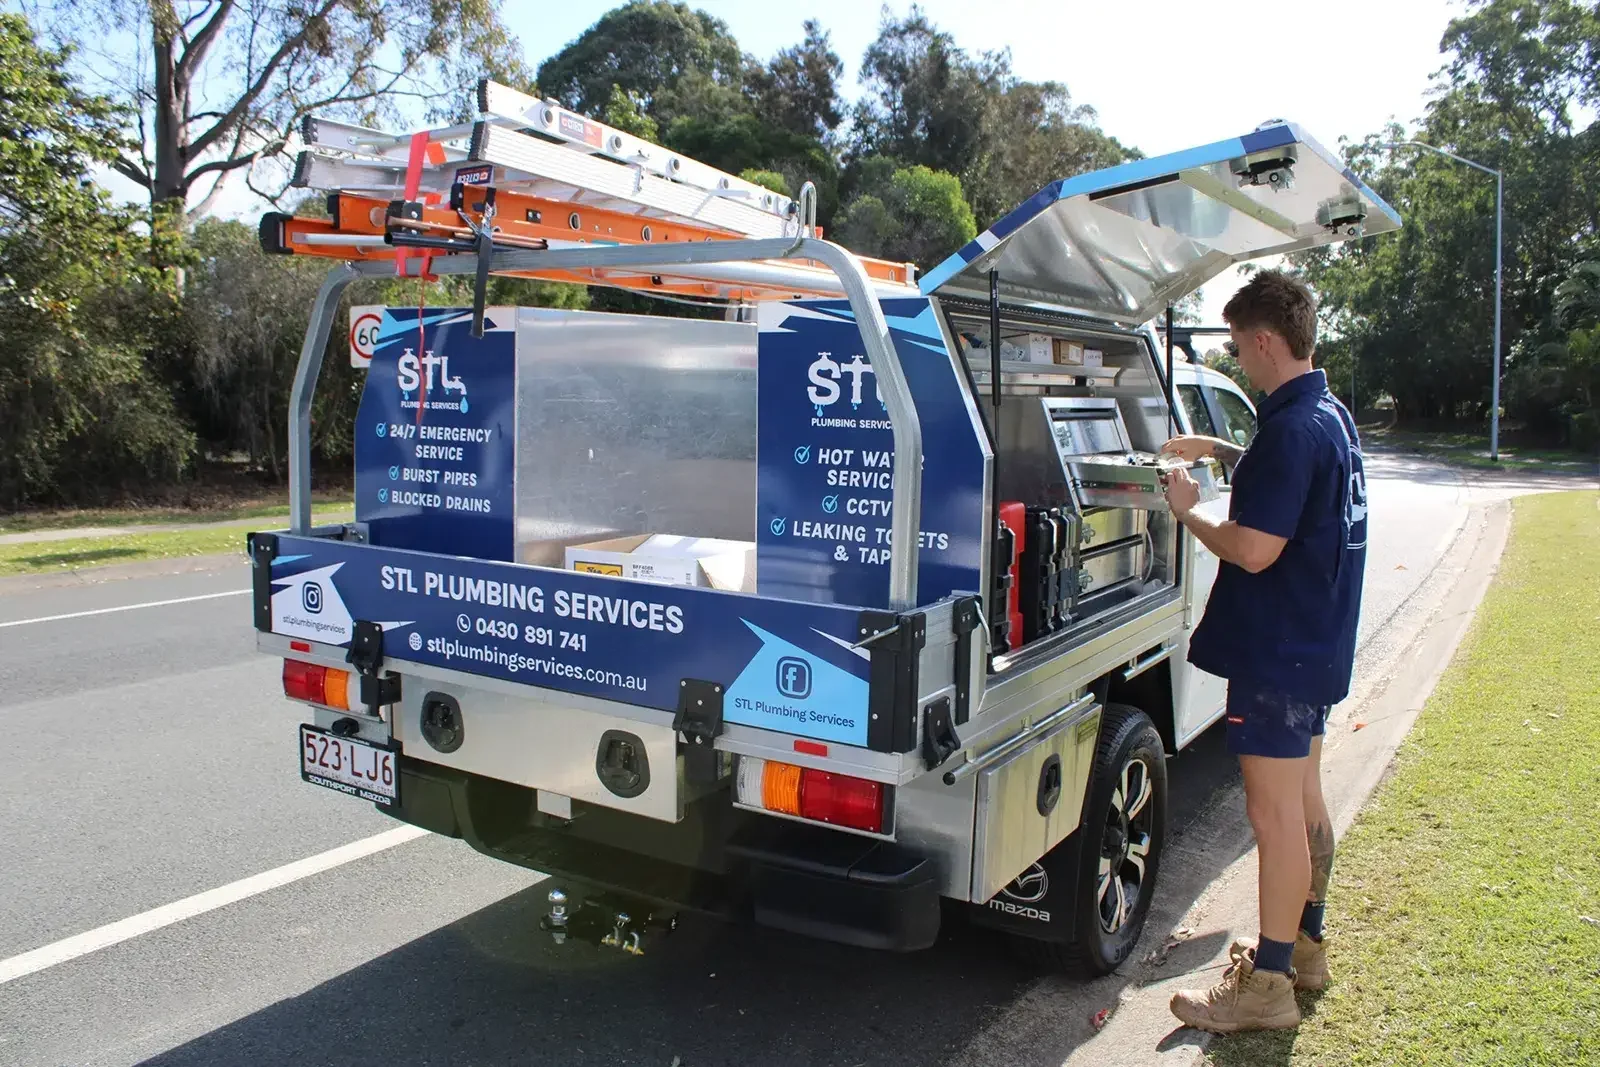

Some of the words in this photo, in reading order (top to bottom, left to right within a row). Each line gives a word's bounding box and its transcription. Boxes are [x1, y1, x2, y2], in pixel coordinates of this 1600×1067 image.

[358, 326, 380, 346] 60
[431, 401, 459, 410] SERVICES
[390, 423, 416, 440] 24/7
[419, 425, 492, 443] EMERGENCY
[811, 417, 857, 429] PLUMBING
[859, 419, 893, 430] SERVIC
[415, 444, 463, 461] SERVICE
[817, 448, 854, 466] HOT
[403, 467, 440, 483] BURST
[443, 471, 477, 487] PIPES
[391, 490, 441, 508] BLOCKED
[445, 495, 491, 513] DRAINS
[846, 498, 892, 517] CCTV
[792, 520, 866, 543] LEAKING
[875, 527, 949, 550] TOETS
[833, 545, 849, 562] &
[381, 565, 418, 593] STL
[425, 571, 544, 613] PLUMBING
[554, 590, 684, 634] SERVICES
[282, 615, 346, 635] stlplumbingservices
[476, 617, 519, 640] 0430
[524, 625, 553, 646] 891
[559, 630, 587, 652] 741
[427, 637, 647, 691] stlplumbingservices.com.au
[735, 697, 753, 711] STL
[755, 701, 807, 723] Plumbing
[809, 710, 855, 729] Services
[308, 775, 357, 795] SOUTHPORT
